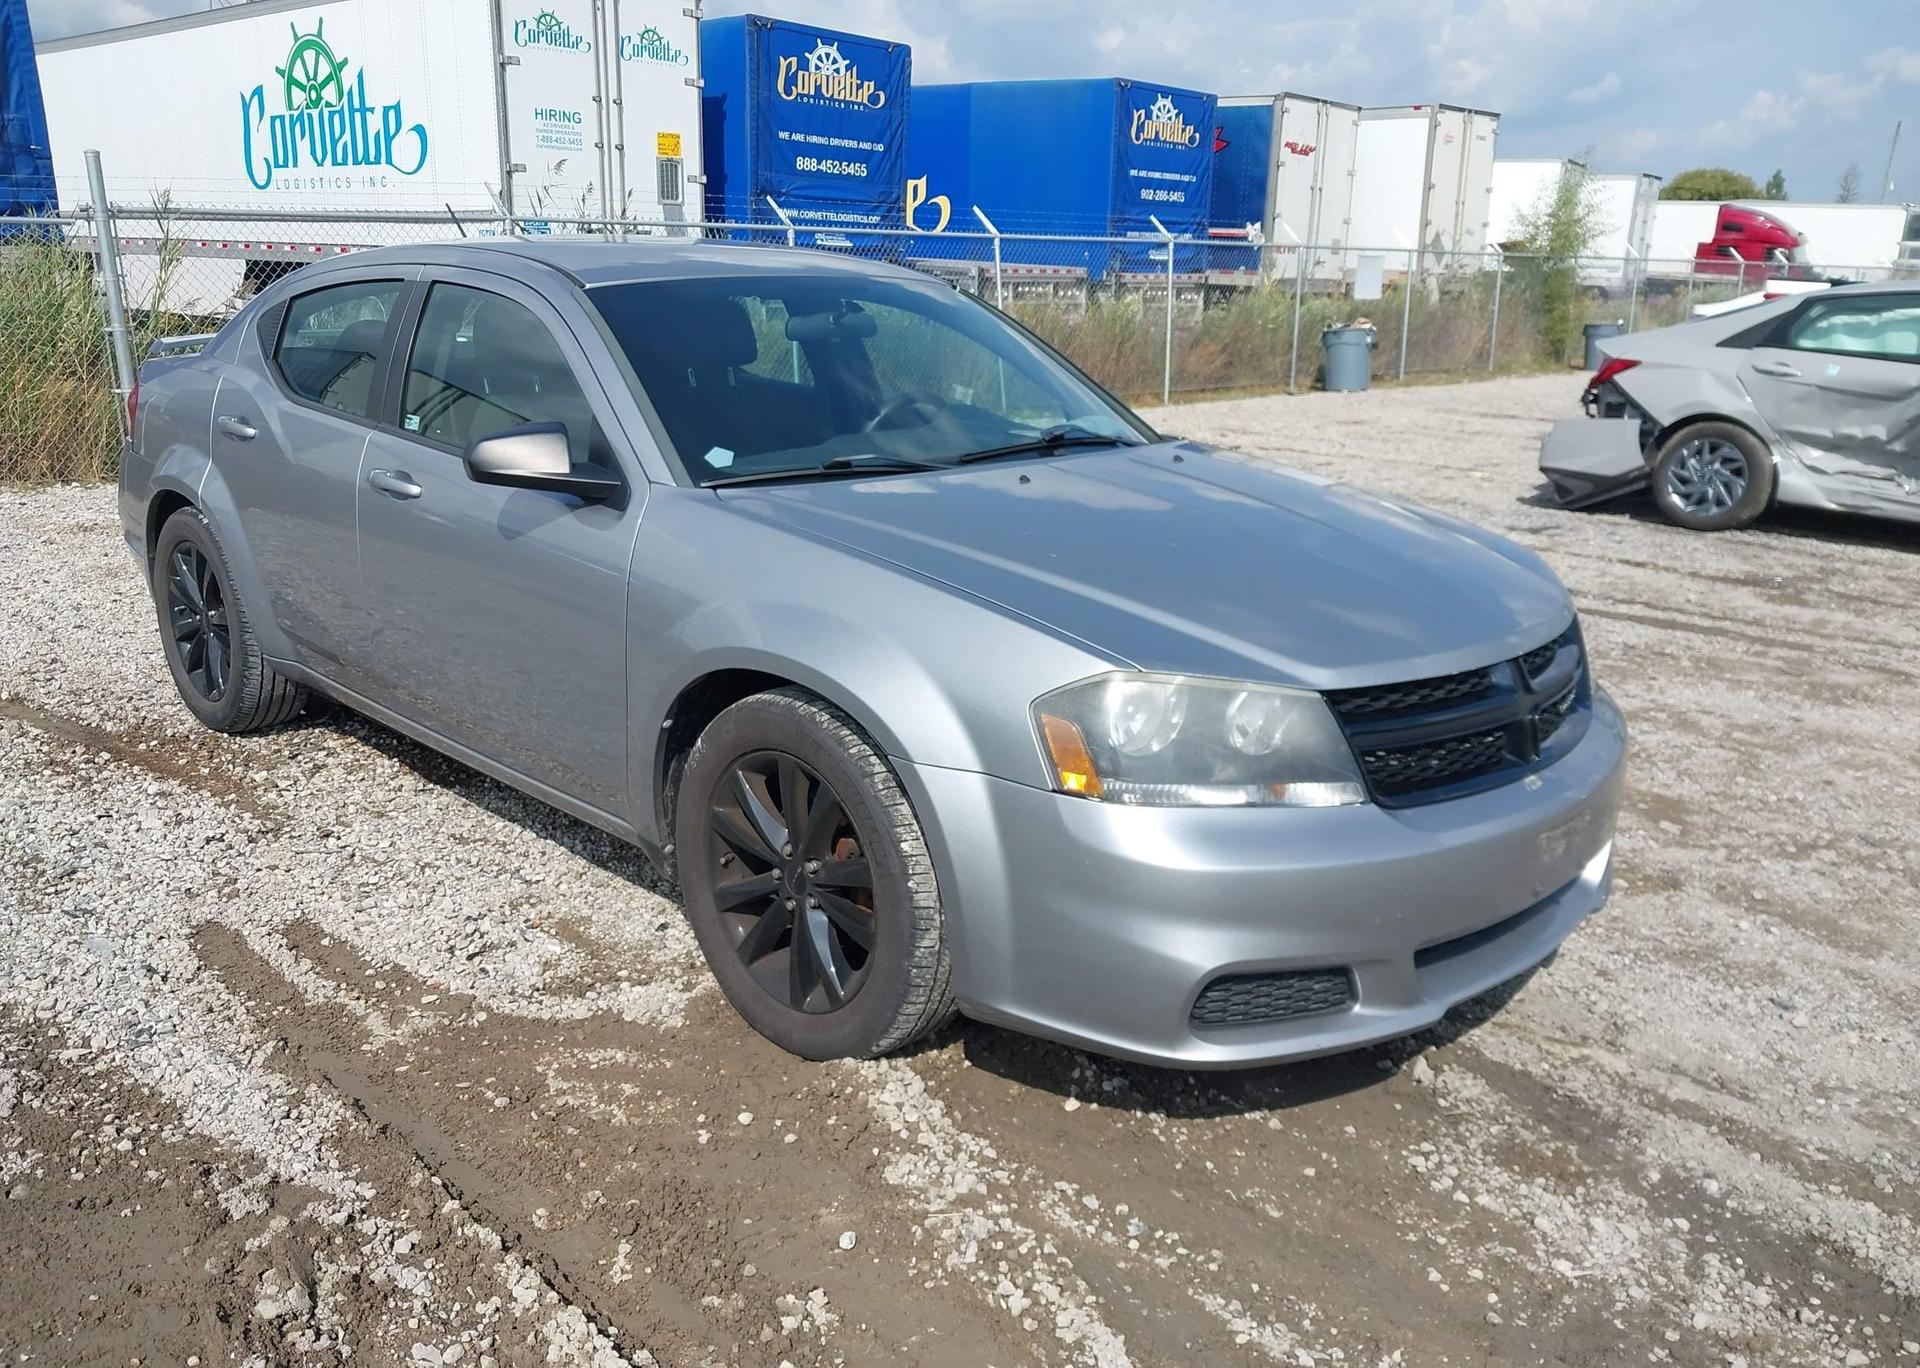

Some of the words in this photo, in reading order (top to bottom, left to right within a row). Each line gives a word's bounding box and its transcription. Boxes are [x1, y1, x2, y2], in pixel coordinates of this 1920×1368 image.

[514, 18, 591, 53] Corvette
[620, 35, 689, 66] Corvette
[777, 55, 885, 109] Corvette
[797, 96, 845, 108] LOGISTICS
[534, 107, 582, 124] HIRING
[240, 66, 428, 190] Corvette
[535, 127, 553, 135] OWNER
[553, 129, 583, 137] OPERATORS
[1131, 108, 1200, 148] Corvette
[535, 134, 583, 147] 1-888-452-5455
[778, 130, 790, 140] WE
[791, 132, 805, 142] ARE
[806, 135, 829, 145] HIRING
[829, 138, 858, 149] DRIVERS
[858, 142, 872, 151] AND
[796, 156, 868, 177] 888-452-5455
[275, 176, 352, 190] LOGISTICS
[361, 175, 396, 189] INC.
[1140, 188, 1185, 203] 902-266-5455
